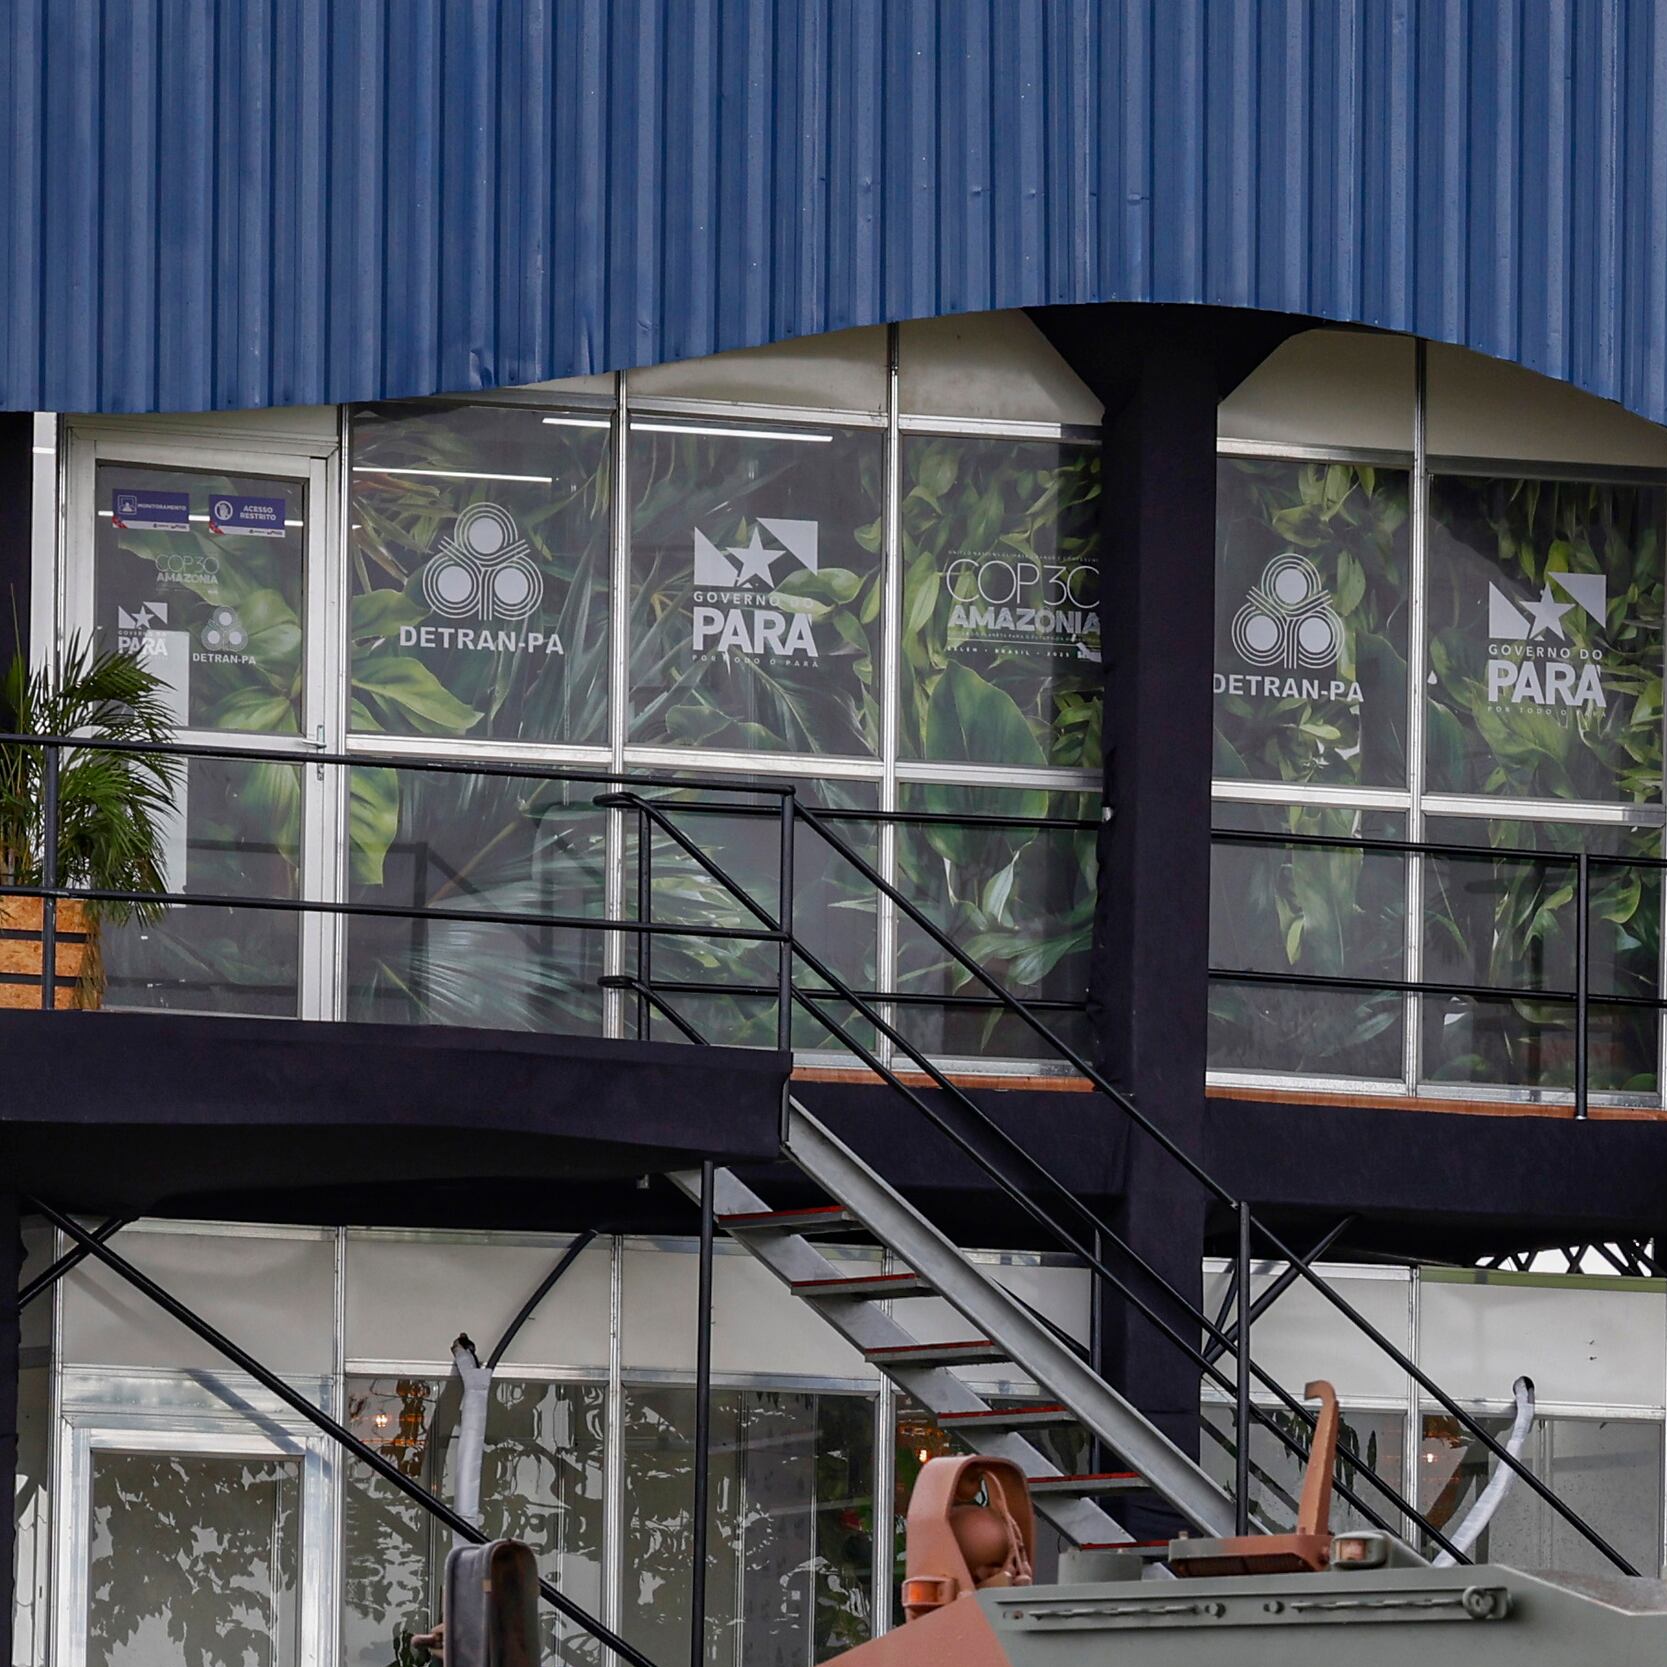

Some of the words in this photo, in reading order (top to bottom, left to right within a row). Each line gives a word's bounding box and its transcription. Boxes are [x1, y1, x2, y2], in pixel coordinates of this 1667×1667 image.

[240, 512, 277, 521] RESTRITO
[242, 504, 274, 514] ACESSO
[693, 590, 780, 607] GOVERNO
[399, 625, 565, 655] DETRAN-PA
[692, 606, 819, 658] PARÁ
[191, 652, 257, 666] DETRAN-PA
[1488, 643, 1571, 659] GOVERNO
[1580, 648, 1603, 661] DO
[1213, 673, 1364, 702] DETRAN-PA
[1487, 659, 1607, 708] PARÁ
